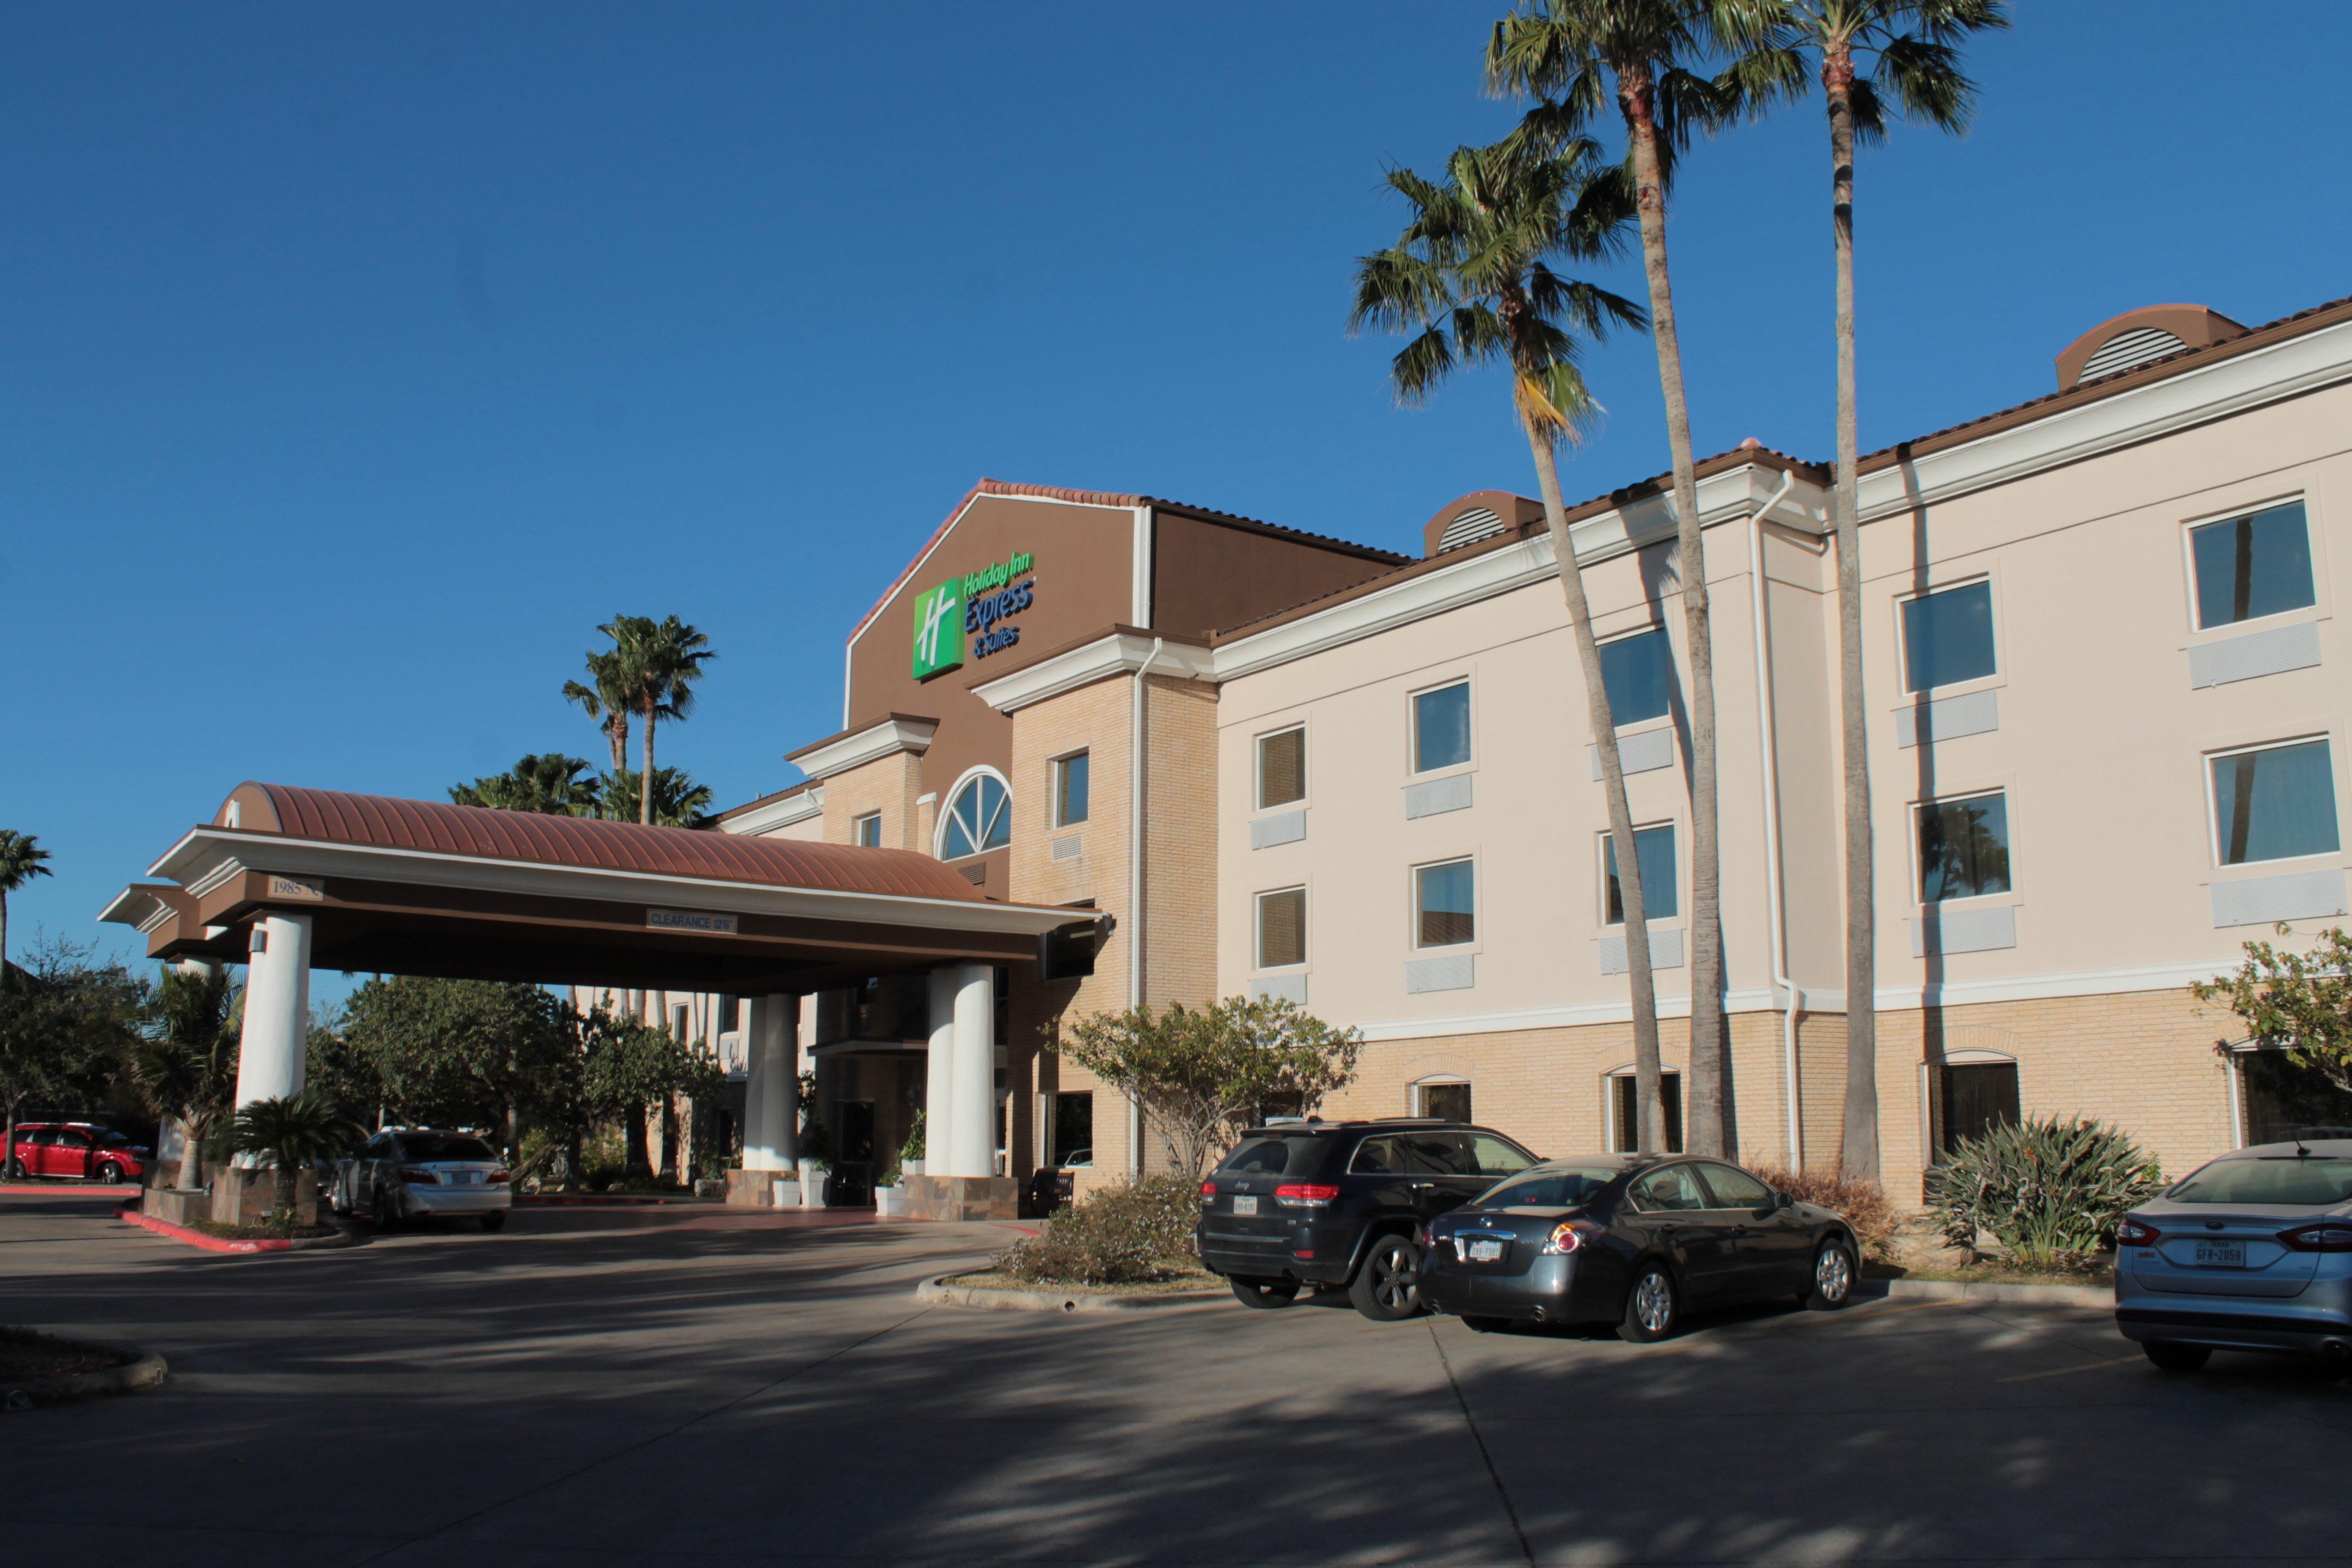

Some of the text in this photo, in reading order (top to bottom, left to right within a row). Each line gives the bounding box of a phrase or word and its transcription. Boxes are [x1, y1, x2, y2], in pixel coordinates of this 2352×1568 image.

[963, 552, 1034, 597] Holiday Inn
[964, 580, 1033, 633] Express
[973, 626, 1020, 658] & Suites
[273, 880, 302, 895] 1985
[651, 913, 711, 929] CLEARANCE
[1234, 1180, 1250, 1190] Jeep
[2196, 1248, 2241, 1261] GFR-2059
